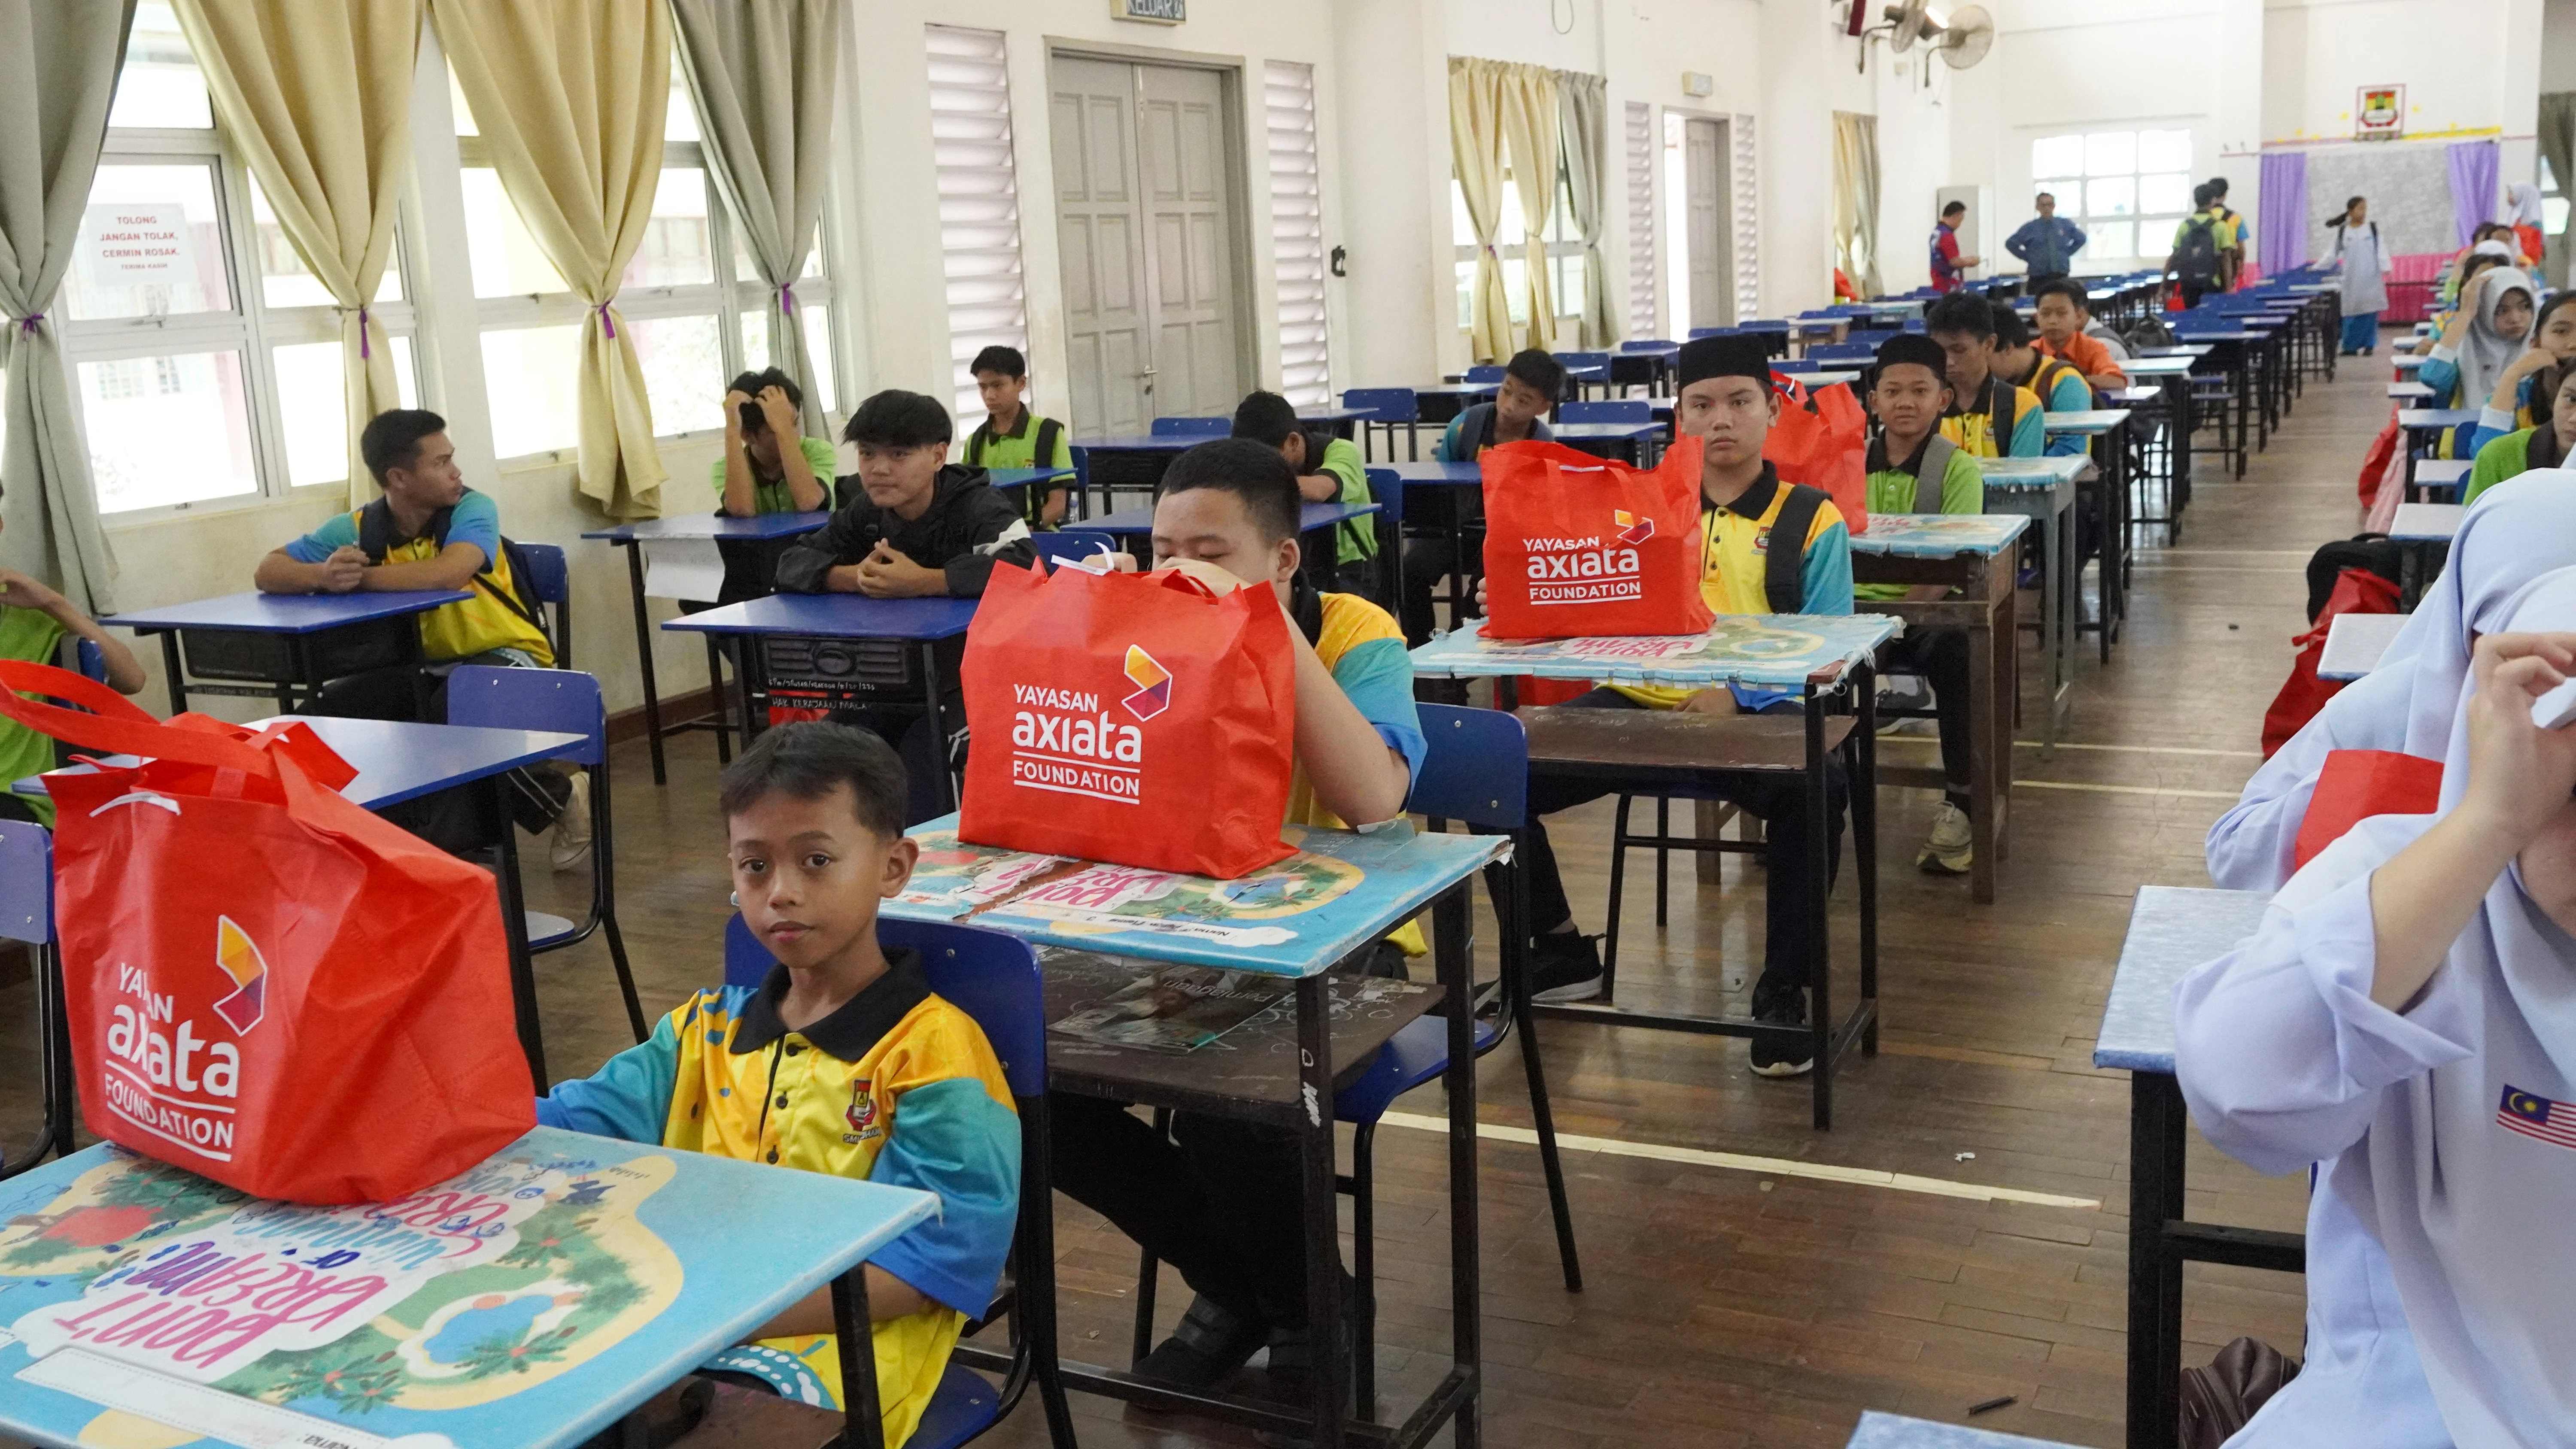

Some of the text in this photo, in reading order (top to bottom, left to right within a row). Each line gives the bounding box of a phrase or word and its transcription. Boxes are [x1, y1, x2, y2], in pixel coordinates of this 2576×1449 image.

[116, 215, 157, 224] TOLONG
[99, 233, 140, 241] JANGAN
[102, 249, 142, 258] CERMIN
[1522, 536, 1600, 552] YAYASAN
[1527, 543, 1640, 579] axiata
[1529, 581, 1642, 600] FOUNDATION
[1014, 684, 1098, 713] YAYASAN
[1012, 710, 1142, 763] axiata
[1013, 760, 1139, 797] FOUNDATION
[104, 1073, 234, 1149] FOUNDATION
[124, 1241, 389, 1331] DREAM
[53, 1292, 282, 1369] DON'T
